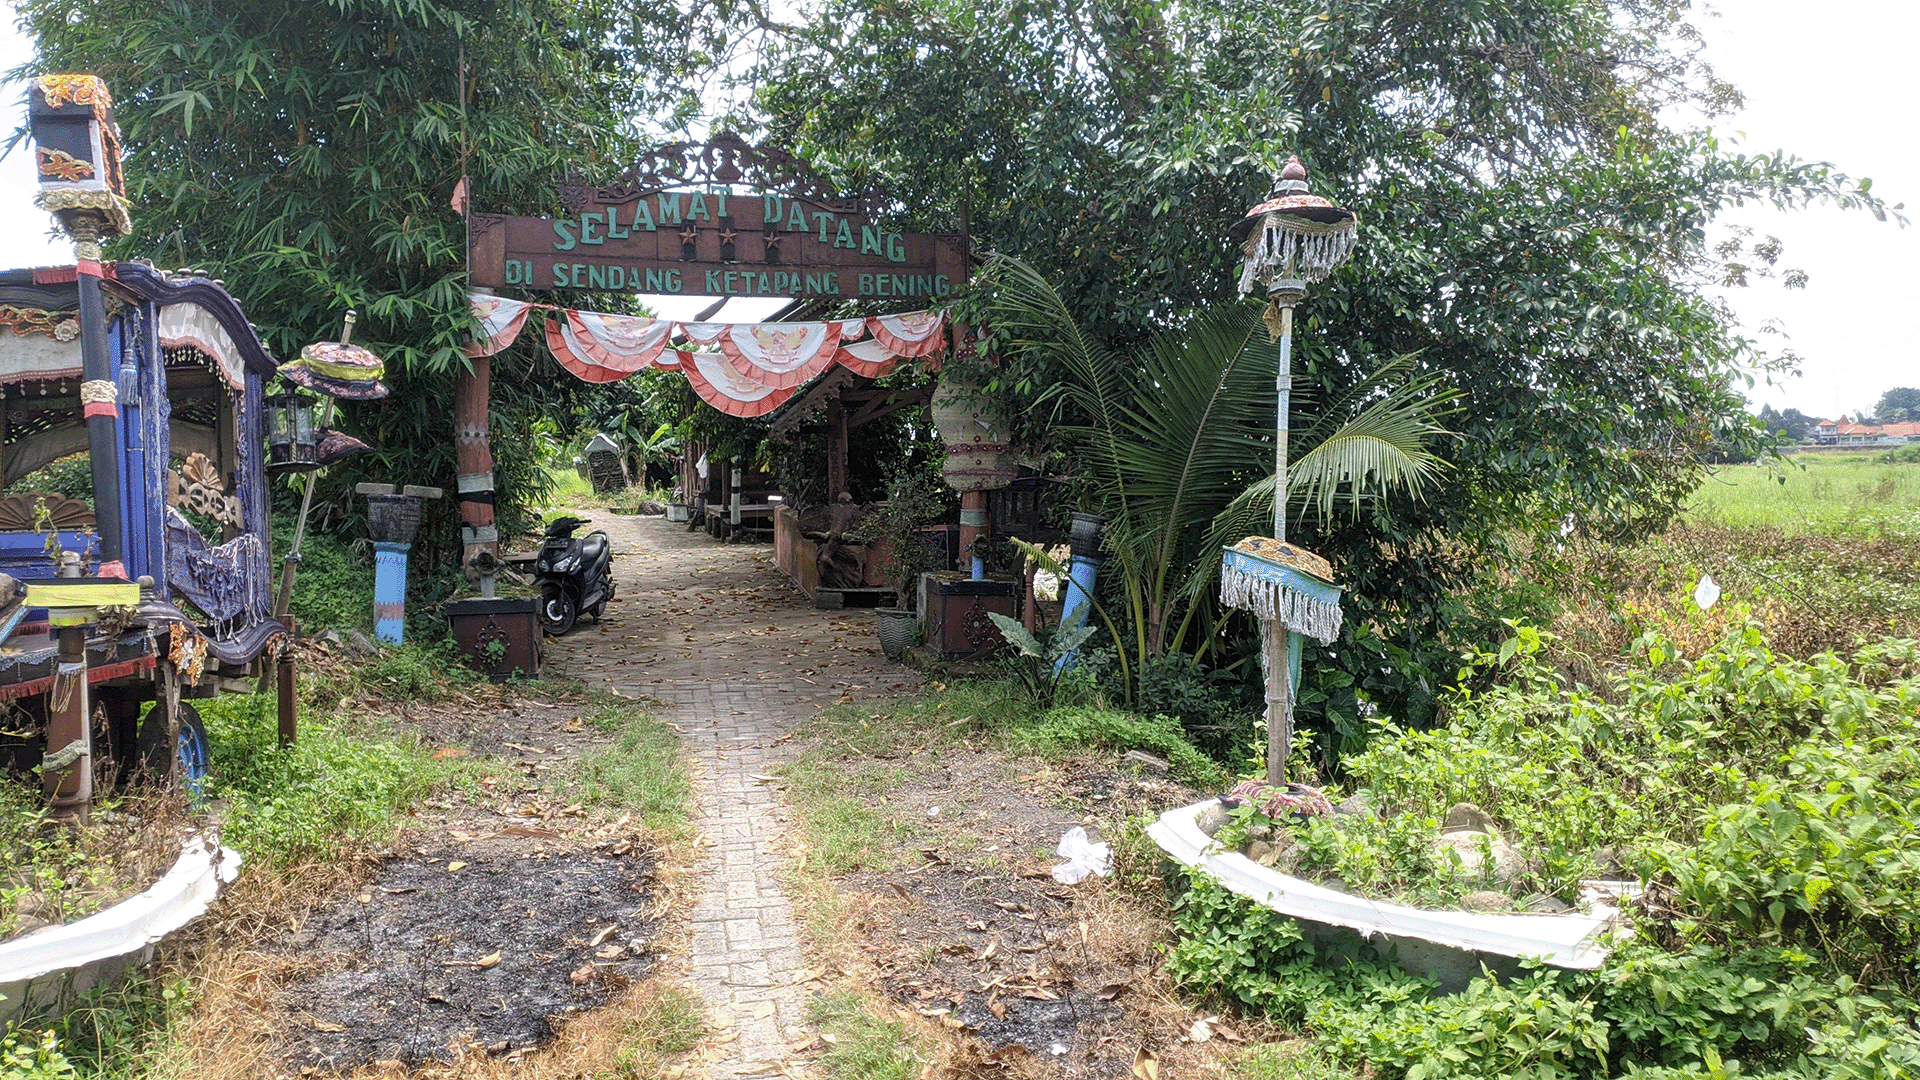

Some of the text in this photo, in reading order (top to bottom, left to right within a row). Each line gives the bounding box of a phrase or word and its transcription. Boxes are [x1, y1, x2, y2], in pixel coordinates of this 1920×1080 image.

[552, 186, 906, 262] SELAMAT DATANG
[505, 259, 950, 297] DI SENDANG KETAPANG BENING
